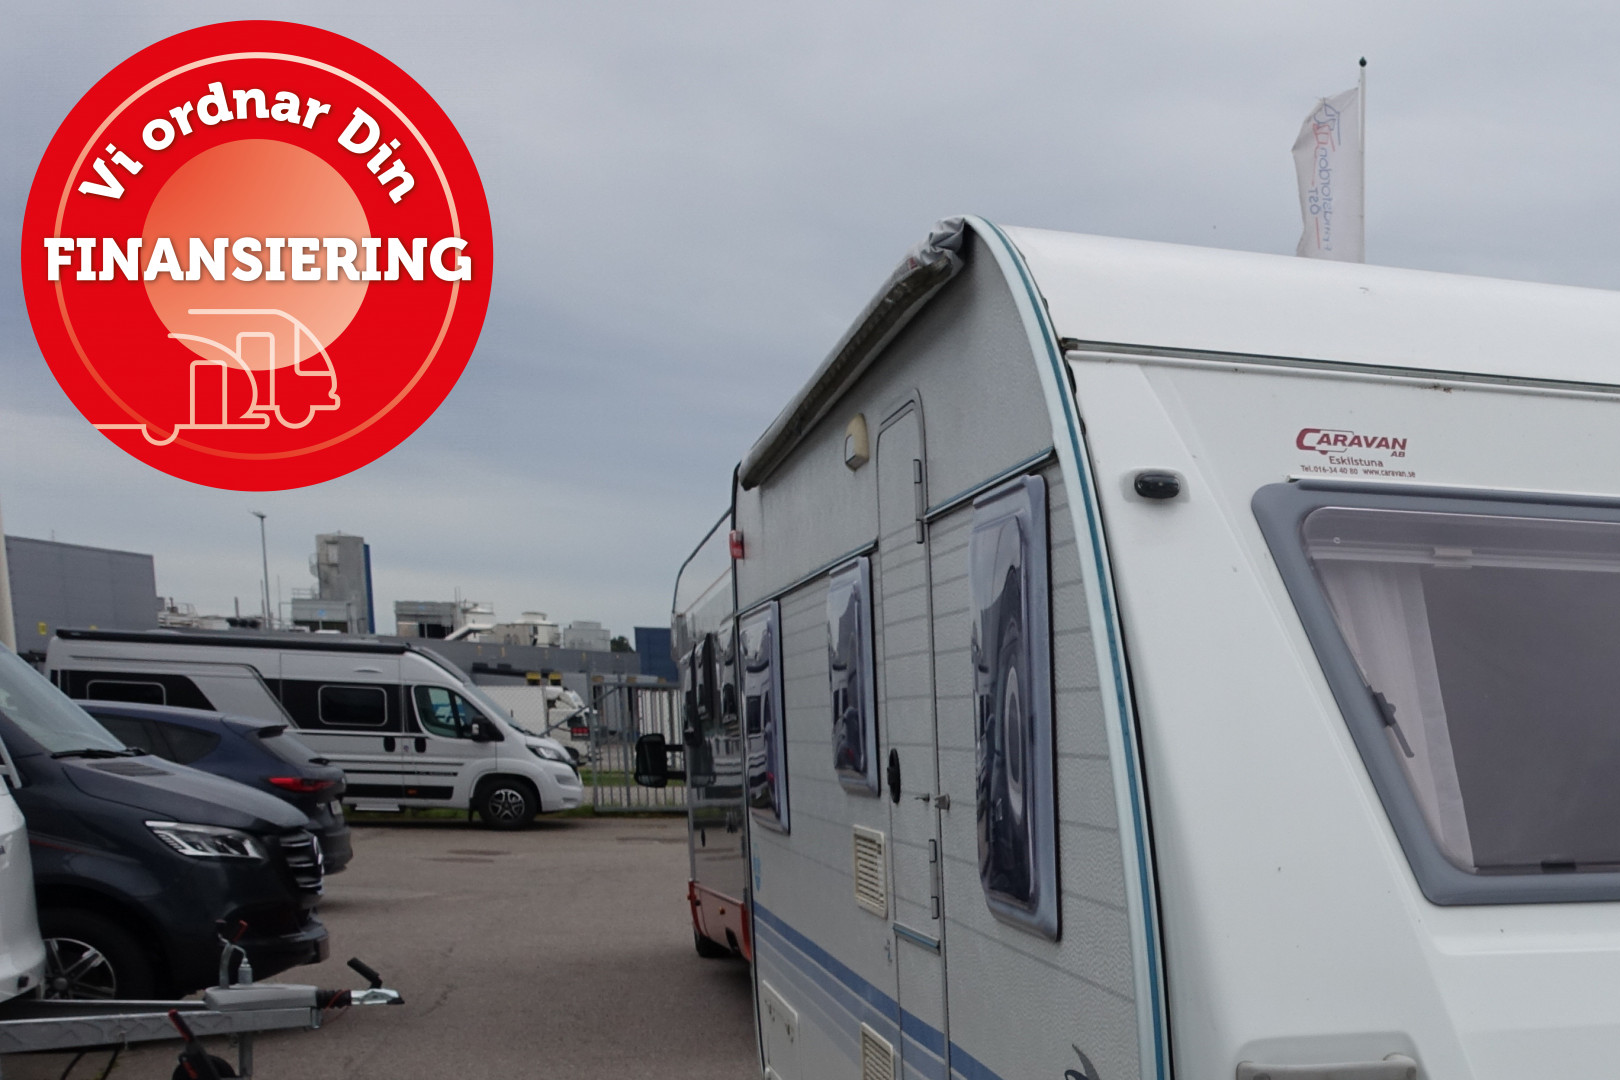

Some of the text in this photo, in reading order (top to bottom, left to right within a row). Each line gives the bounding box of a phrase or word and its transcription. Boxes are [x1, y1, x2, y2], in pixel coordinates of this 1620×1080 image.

[1296, 428, 1408, 451] CARAVAN
[1329, 456, 1384, 467] Eskilstuna
[1362, 468, 1416, 478] www.caravan.se
